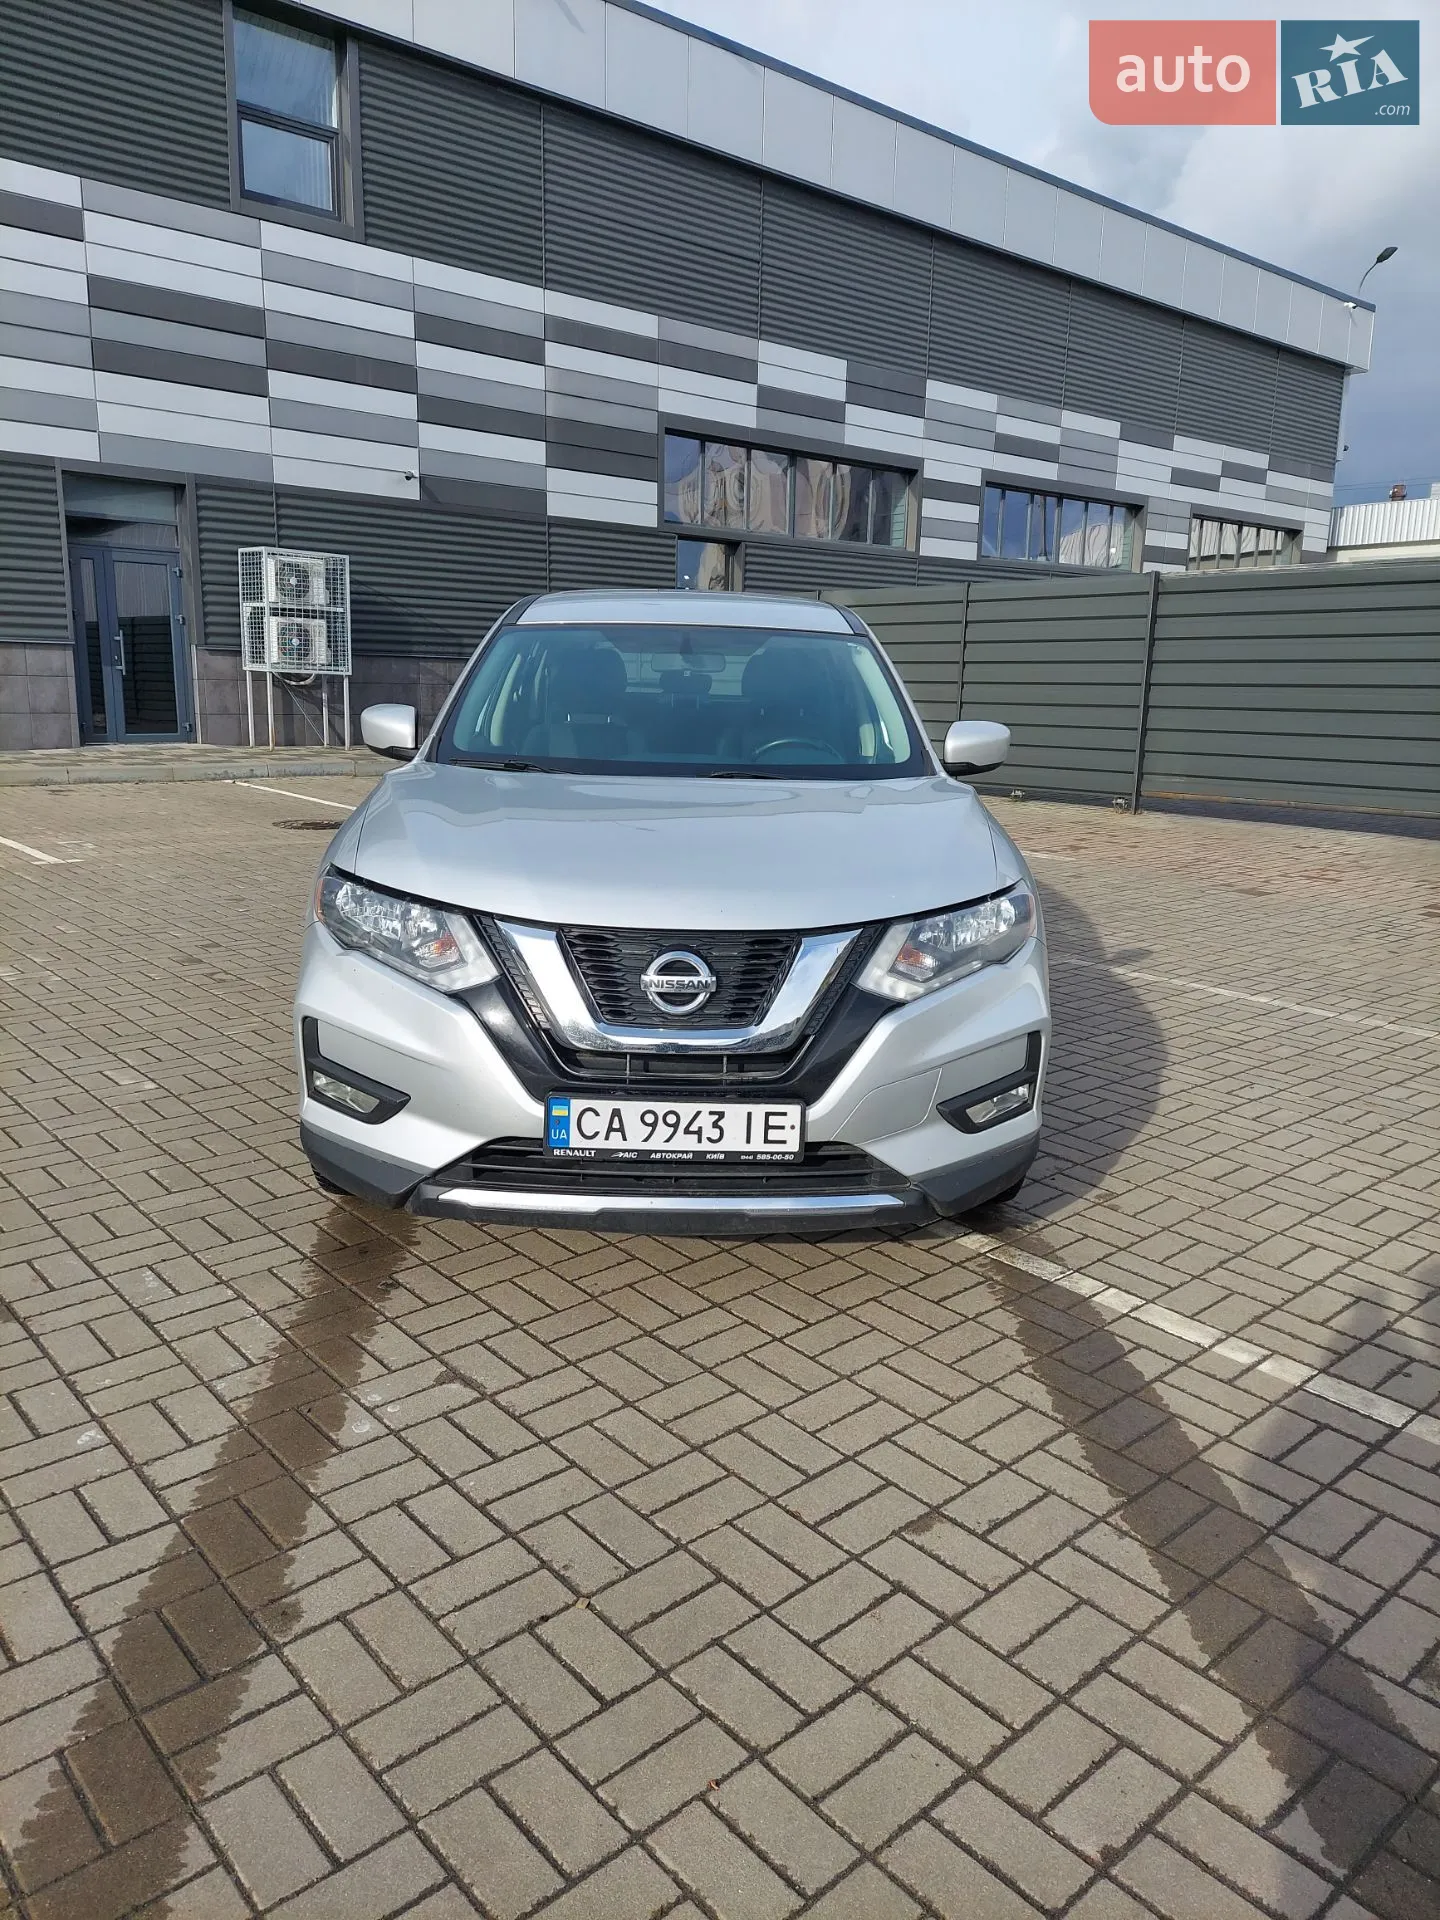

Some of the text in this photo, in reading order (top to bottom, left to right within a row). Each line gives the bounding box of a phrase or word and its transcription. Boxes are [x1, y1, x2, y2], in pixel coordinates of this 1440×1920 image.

[649, 979, 708, 990] NISSAN
[576, 1106, 628, 1141] CA
[640, 1109, 725, 1144] 9943
[551, 1129, 567, 1139] UA
[553, 1148, 597, 1157] RENAULT
[650, 1152, 693, 1160] АВТОКРАЙ
[756, 1153, 794, 1161] 585-00-50
